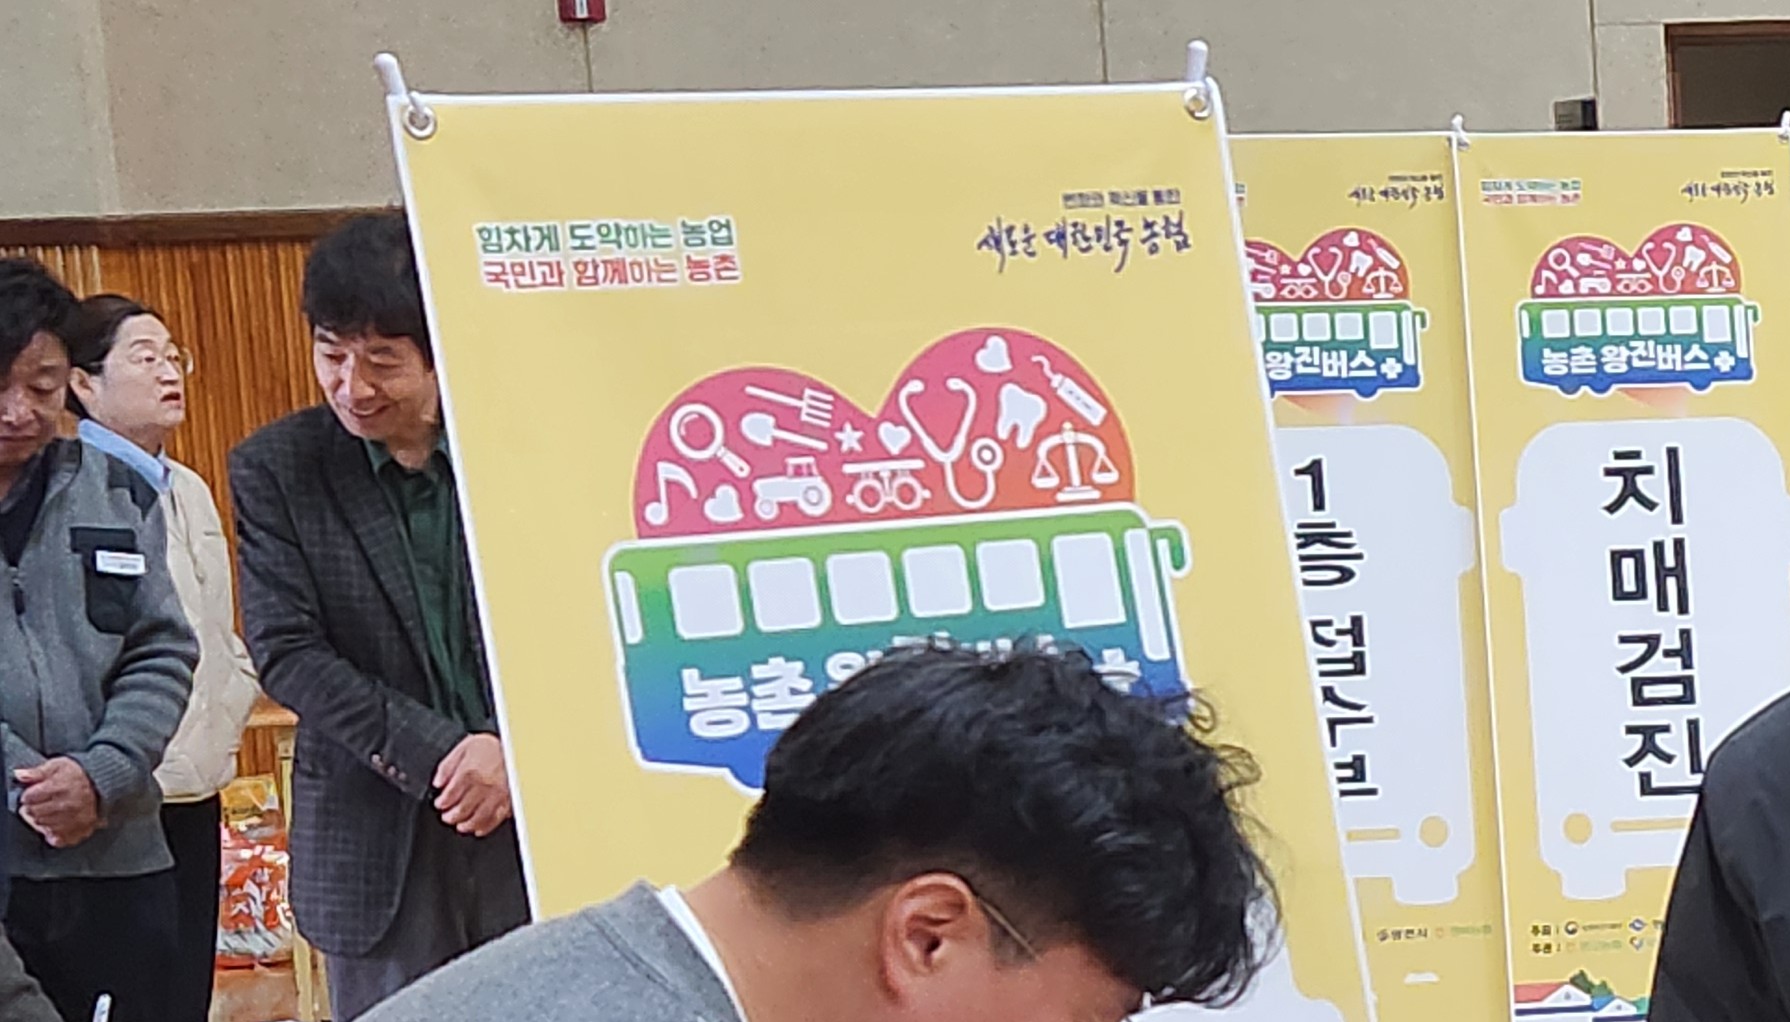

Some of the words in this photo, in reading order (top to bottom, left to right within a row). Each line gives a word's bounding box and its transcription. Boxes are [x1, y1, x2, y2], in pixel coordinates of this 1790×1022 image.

[476, 223, 561, 253] 힘차게
[569, 222, 674, 251] 도약하는
[680, 216, 735, 249] 농업
[483, 260, 565, 289] 국민과
[572, 256, 679, 287] 함께하는
[685, 253, 740, 283] 농촌
[1265, 345, 1378, 381] 왕진버스
[1541, 345, 1598, 376] 농촌
[1600, 340, 1711, 374] 왕진버스
[1602, 446, 1704, 799] 치매검진
